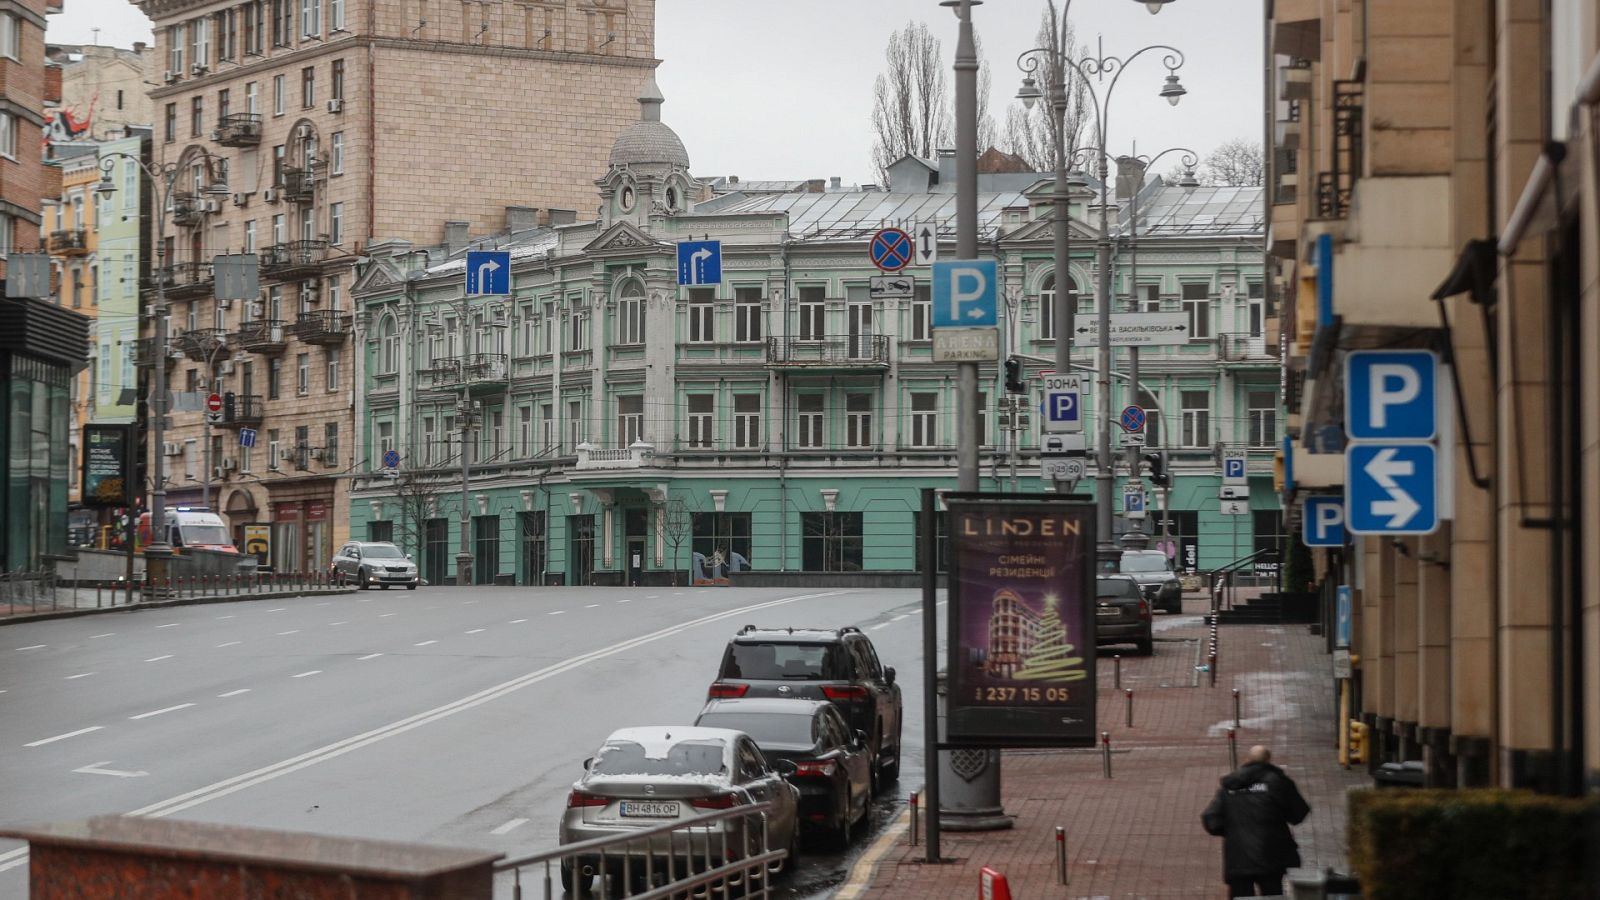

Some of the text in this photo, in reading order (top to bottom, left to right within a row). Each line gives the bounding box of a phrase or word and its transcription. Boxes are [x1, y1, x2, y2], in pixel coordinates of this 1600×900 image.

[951, 268, 985, 320] P
[937, 335, 995, 349] ARENA
[944, 350, 986, 359] PARKING
[1047, 379, 1078, 389] ЗОНА
[1369, 364, 1421, 428] P
[1056, 395, 1073, 419] P
[1068, 464, 1080, 473] 50
[1230, 461, 1240, 475] P
[1124, 485, 1143, 493] ЗОНА
[1130, 495, 1139, 510] P
[964, 519, 1080, 536] LINDEN
[1316, 503, 1344, 539] P
[998, 554, 1046, 565] СІМЕЙНІ
[989, 567, 1055, 578] РЕЗИДЕНЦІЇ
[987, 688, 1016, 701] 237
[1022, 688, 1040, 701] 15
[1046, 688, 1068, 701] 05
